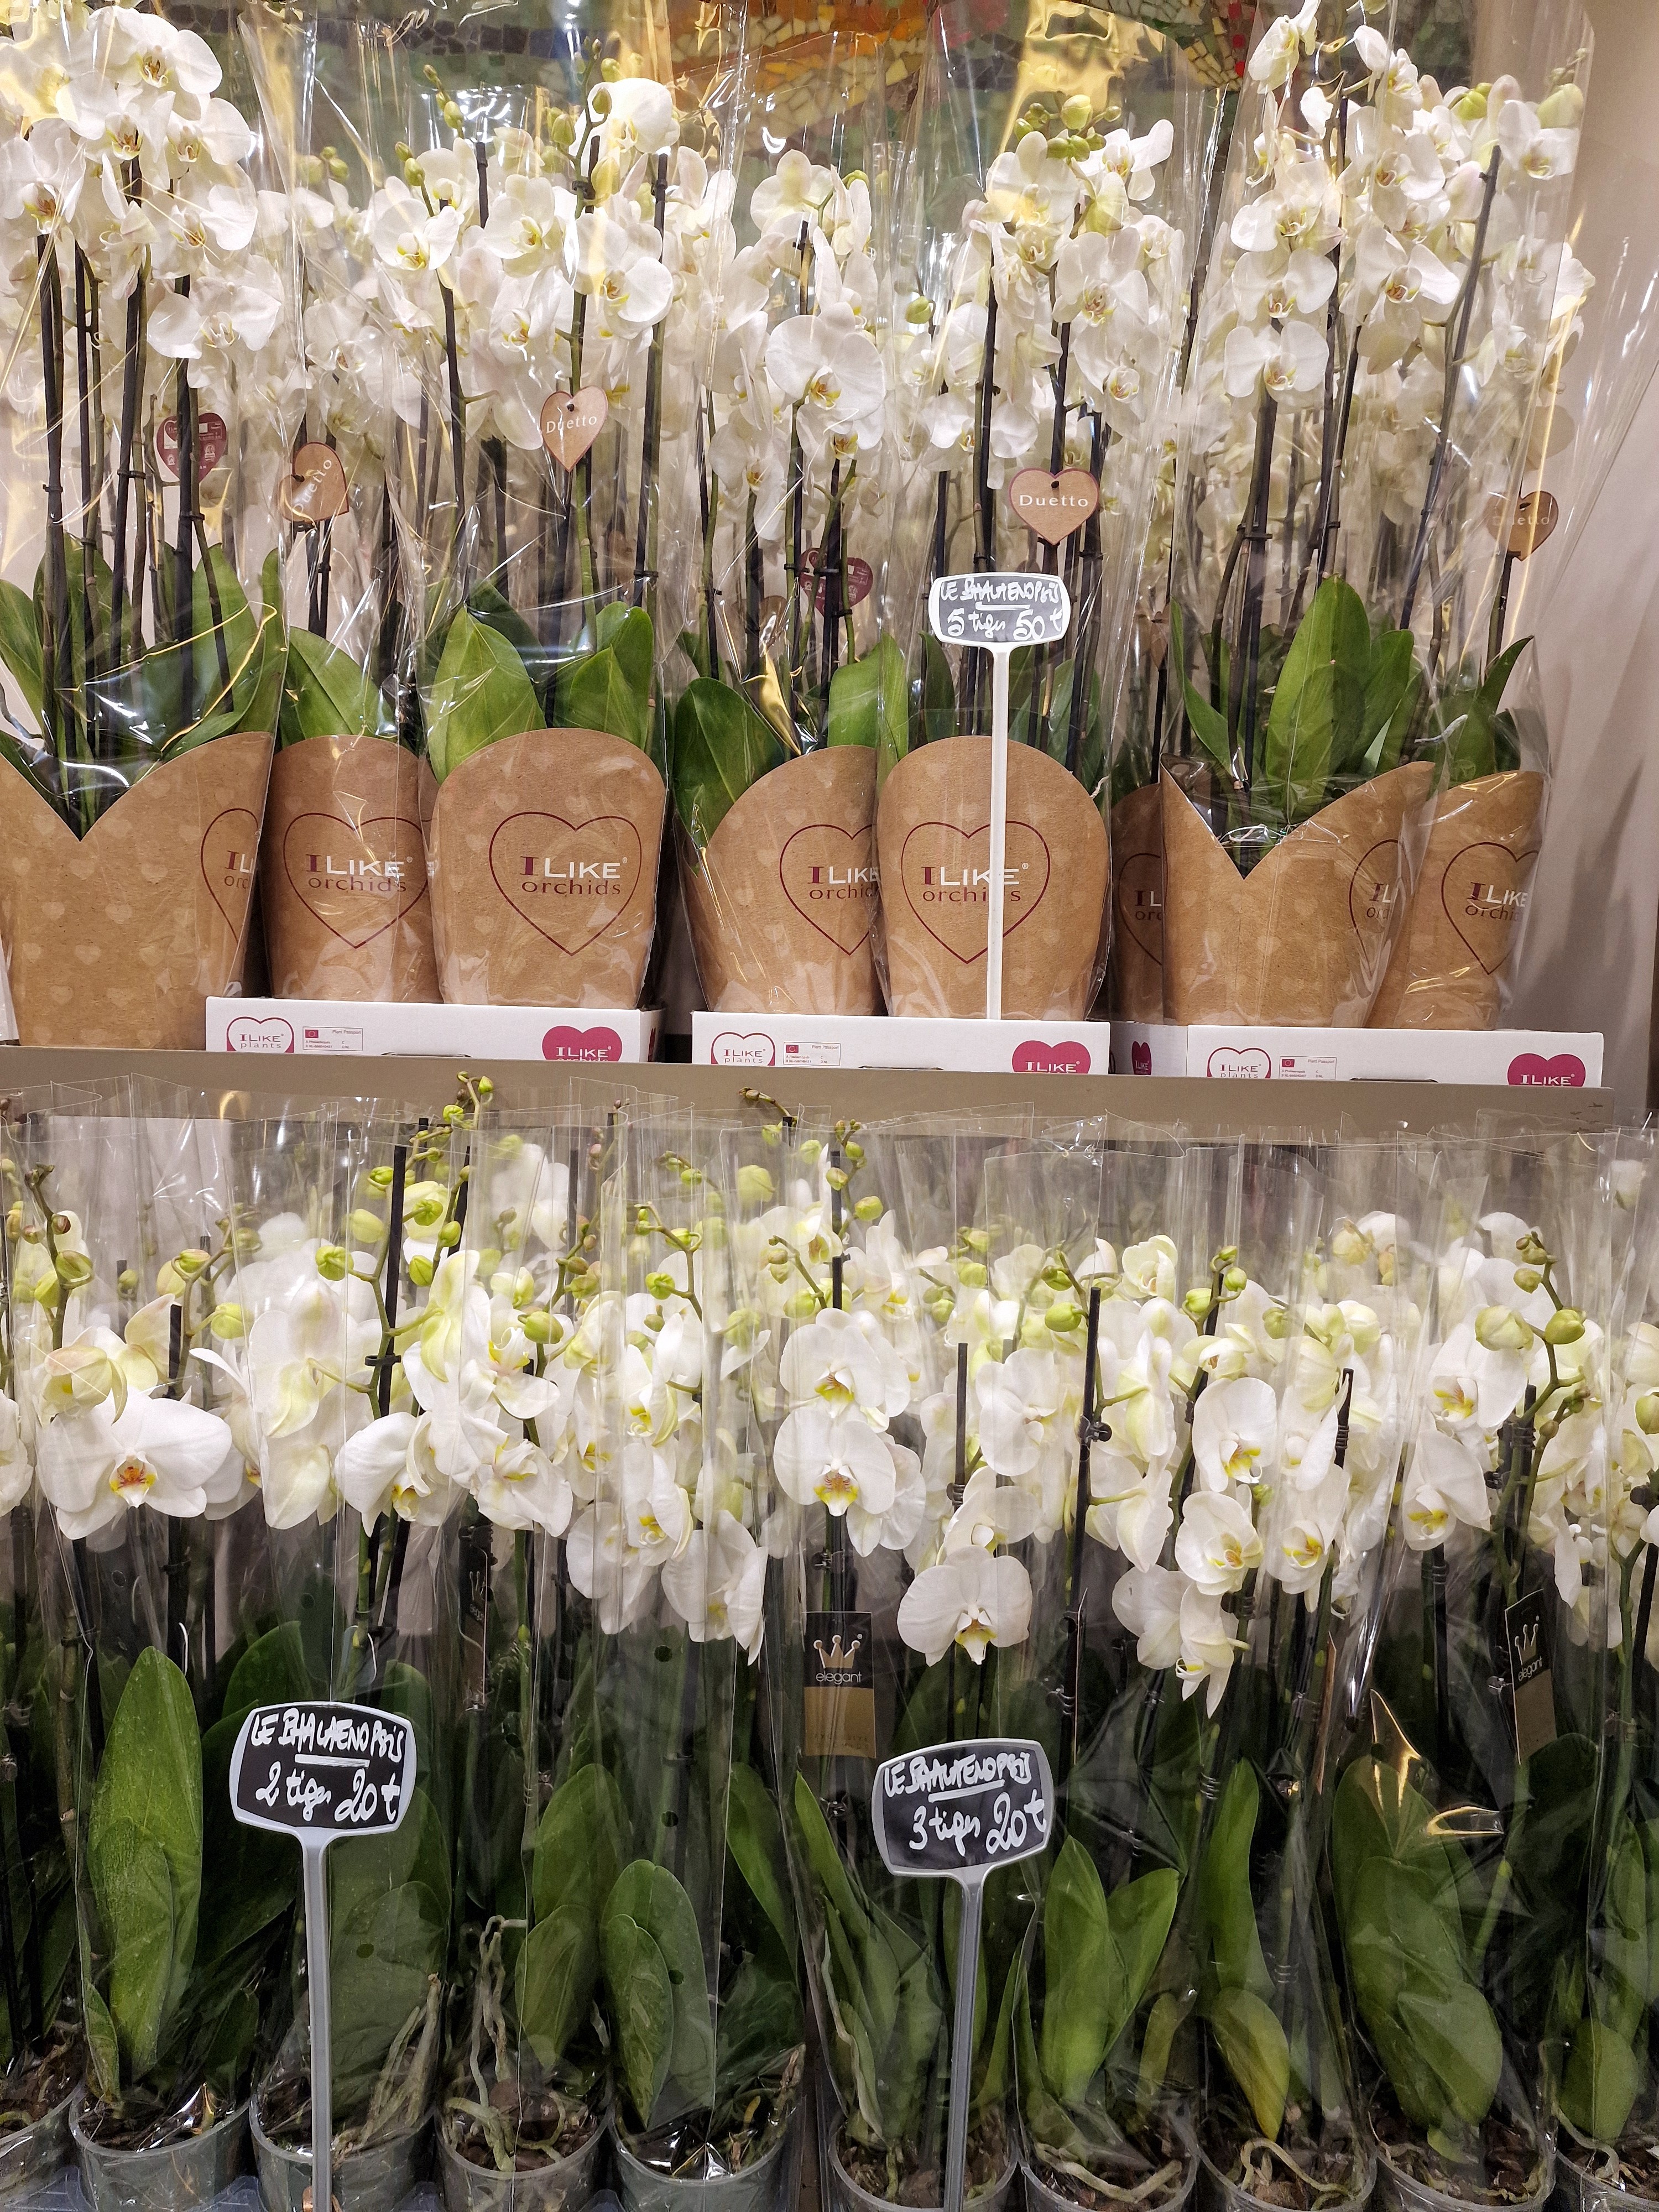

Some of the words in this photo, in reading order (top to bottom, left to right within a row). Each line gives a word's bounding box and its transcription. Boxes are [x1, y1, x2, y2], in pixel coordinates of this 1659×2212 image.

[546, 415, 597, 434] Duetto
[1019, 494, 1089, 507] Duetto
[941, 581, 958, 601] LE
[947, 608, 965, 637] 5
[1013, 609, 1045, 641] 50
[225, 851, 239, 870] I
[305, 854, 321, 872] I
[520, 856, 539, 876] I
[308, 876, 407, 892] orchids
[807, 866, 825, 884] I
[921, 867, 936, 885] I
[521, 879, 620, 895] orchids
[923, 886, 1021, 902] orchis
[1467, 882, 1486, 900] I
[239, 1034, 248, 1042] I
[556, 1047, 565, 1057] I
[1025, 1061, 1034, 1071] I
[1520, 1074, 1530, 1084] I
[816, 1670, 862, 1685] elegant
[1518, 1656, 1543, 1682] elegant
[251, 1713, 279, 1746] LE
[885, 1761, 906, 1798] LE
[255, 1761, 281, 1807] 2
[334, 1768, 378, 1822] 20
[909, 1805, 928, 1850] 3
[986, 1792, 1027, 1854] 20
